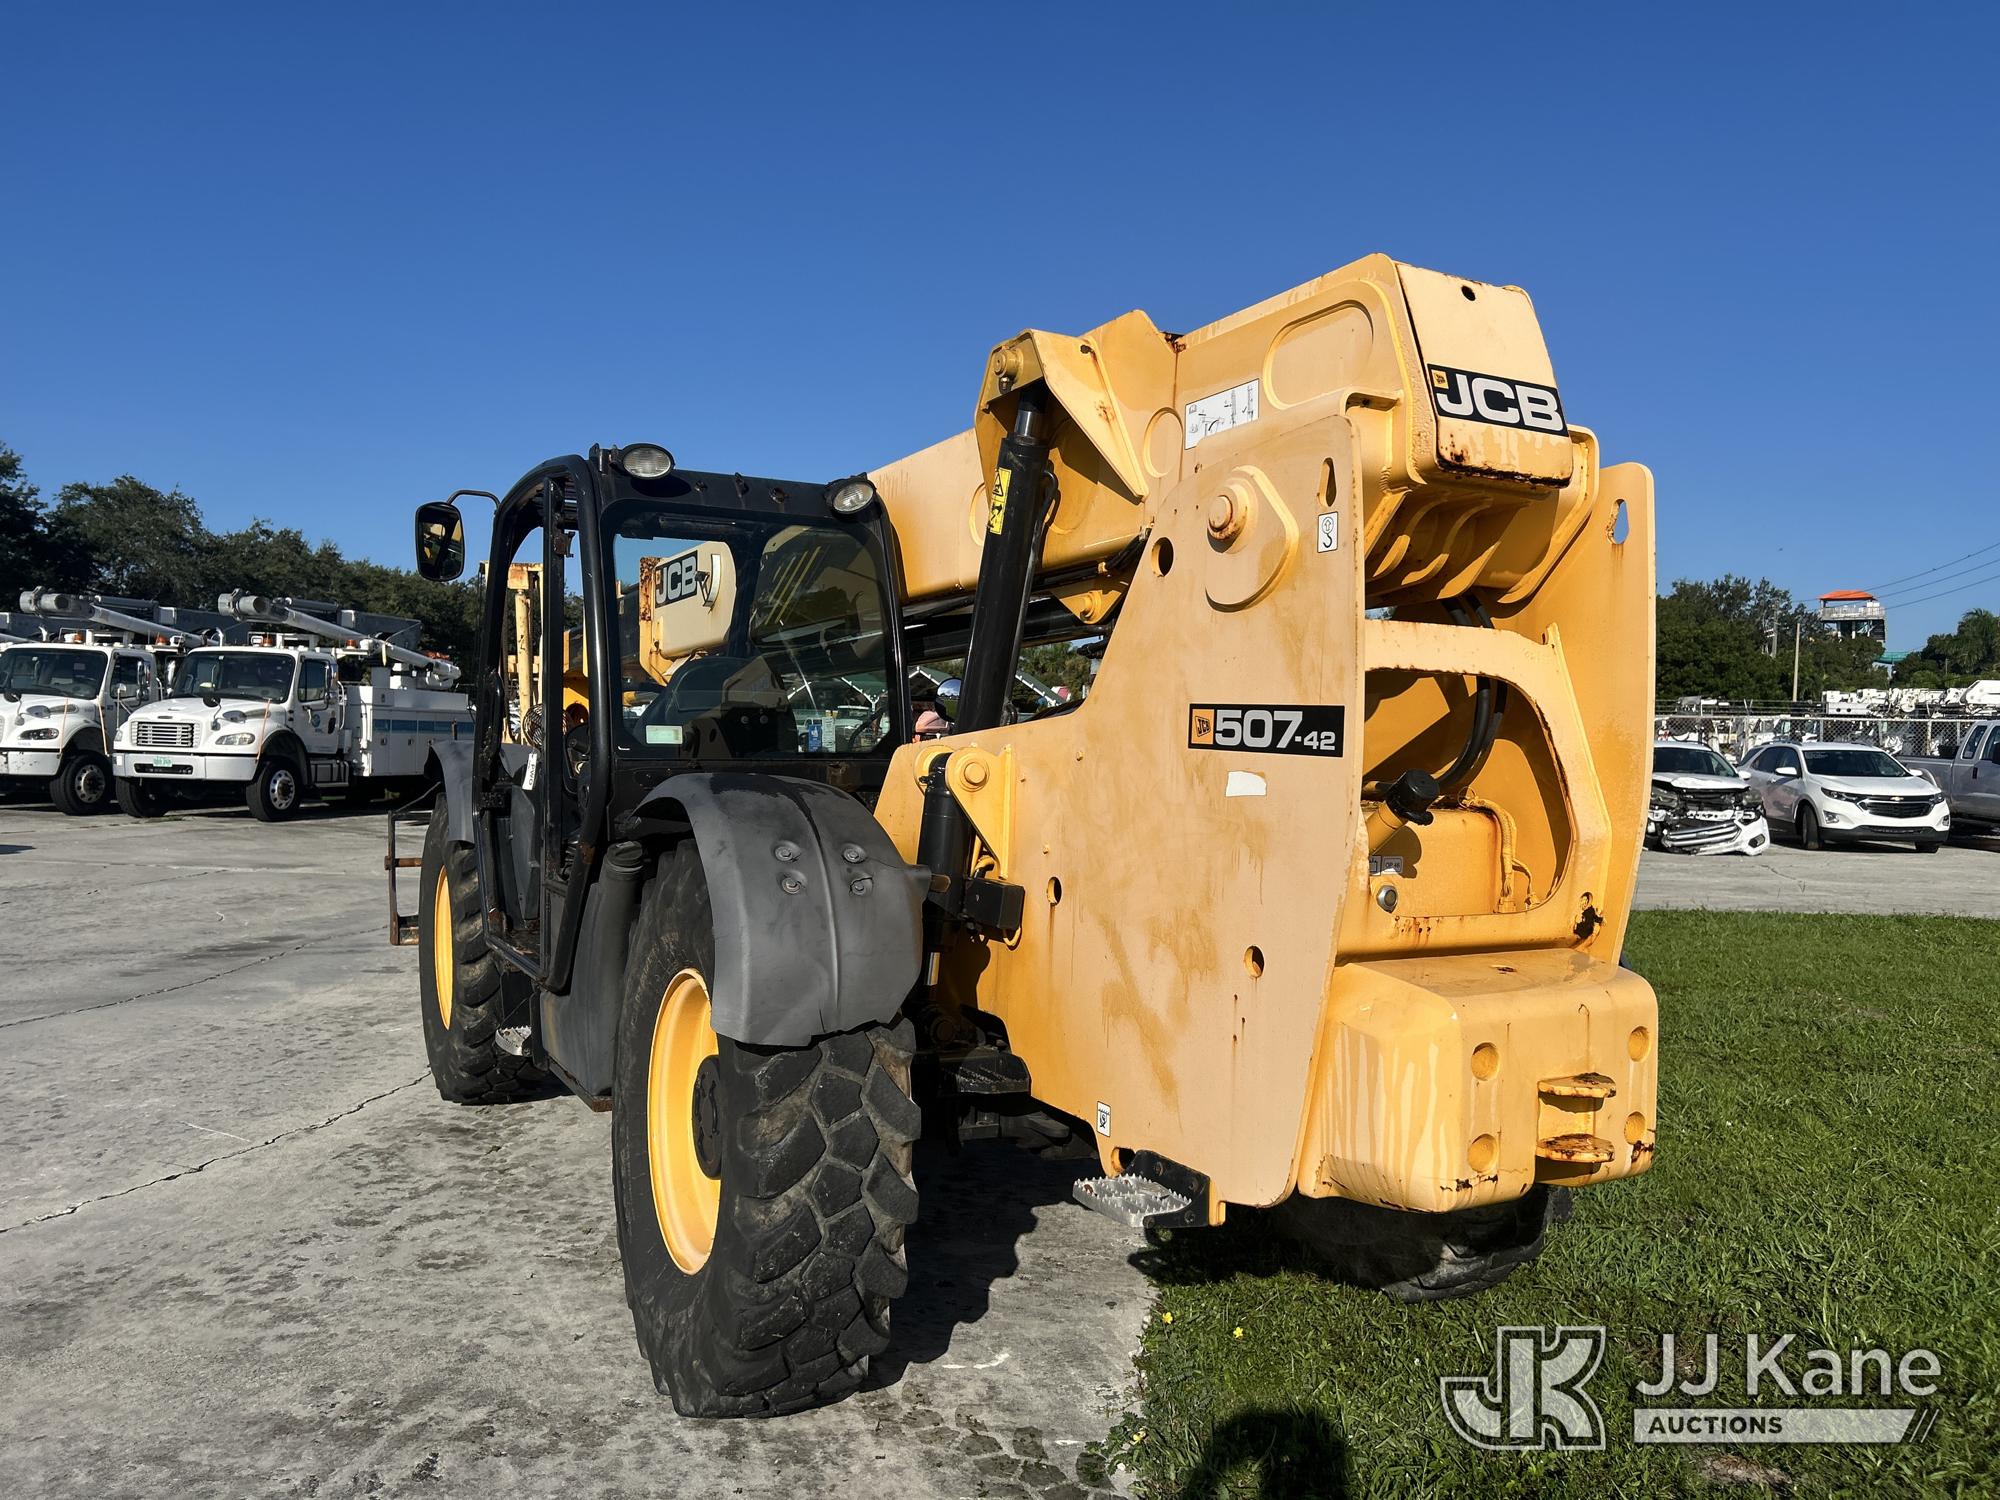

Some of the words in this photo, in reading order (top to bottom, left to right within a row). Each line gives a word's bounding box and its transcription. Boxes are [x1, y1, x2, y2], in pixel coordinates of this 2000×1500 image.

[1436, 373, 1564, 431] JCB
[655, 555, 698, 605] JCB
[1194, 715, 1211, 737] JCB
[1214, 709, 1336, 751] 507-42
